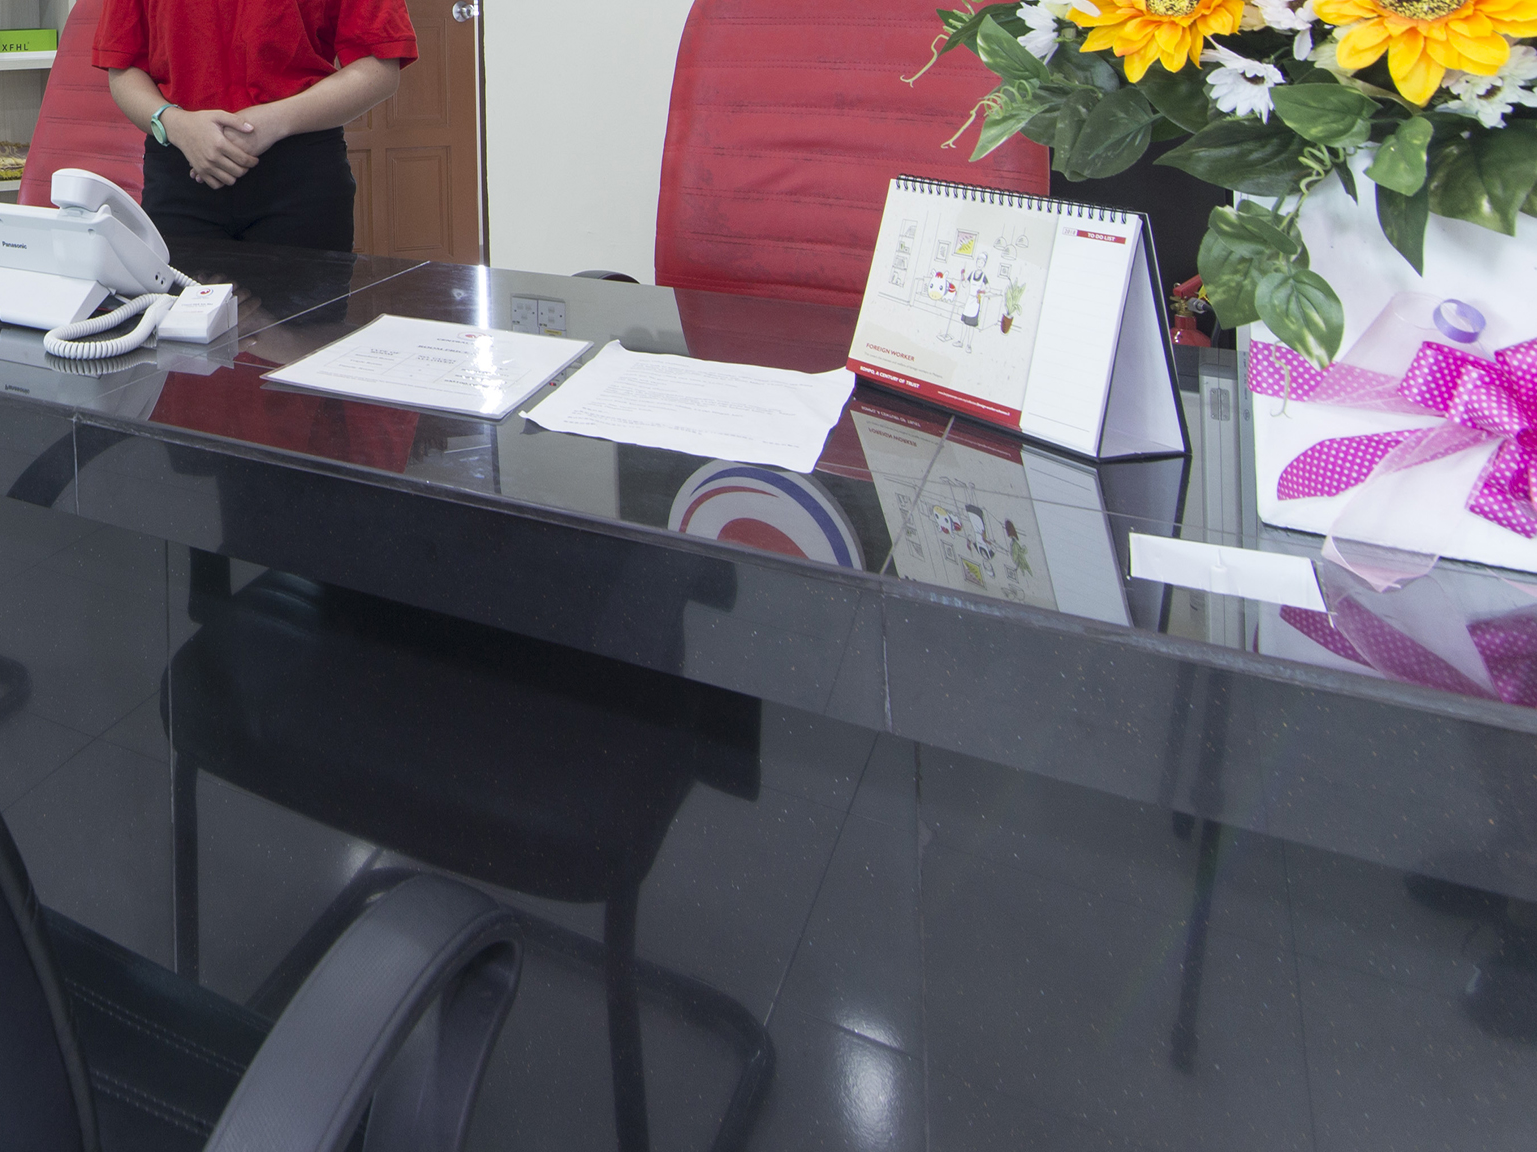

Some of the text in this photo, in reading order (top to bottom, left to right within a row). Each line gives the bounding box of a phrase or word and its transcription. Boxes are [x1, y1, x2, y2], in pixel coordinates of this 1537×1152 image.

[2, 43, 29, 52] XFHL
[2, 240, 27, 249] Panasonic
[866, 343, 890, 355] FOREIGN
[891, 349, 915, 362] WORKER
[880, 372, 899, 383] CENTURY
[906, 379, 920, 389] TRUST
